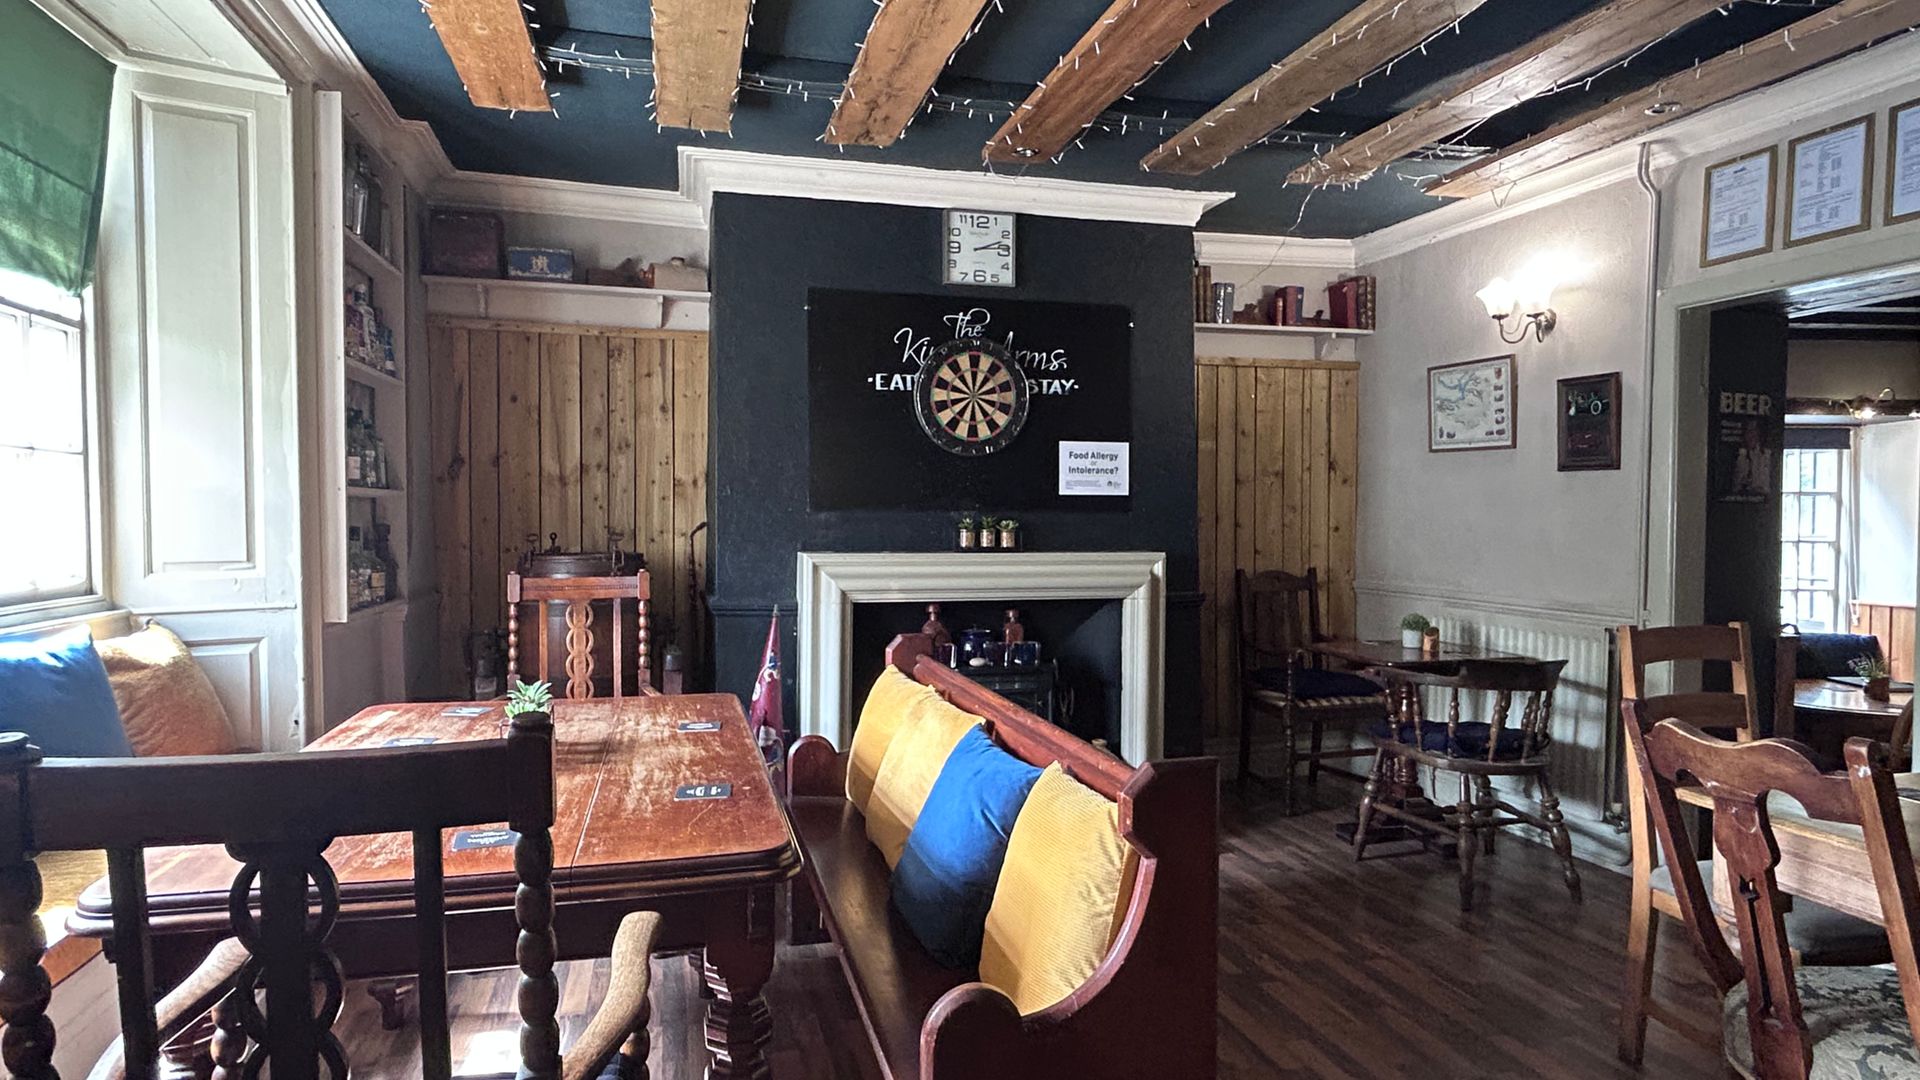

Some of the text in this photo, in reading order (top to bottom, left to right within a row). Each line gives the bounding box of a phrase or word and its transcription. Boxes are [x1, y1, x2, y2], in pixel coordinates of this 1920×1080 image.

[959, 214, 998, 229] 11 12 1
[1001, 230, 1011, 240] 2
[948, 241, 961, 254] 9
[997, 244, 1011, 257] 3
[948, 259, 957, 268] 8
[1001, 262, 1010, 271] 4
[959, 269, 1000, 283] 7 6 5
[943, 308, 991, 339] The
[1720, 391, 1772, 416] BEER
[1068, 451, 1119, 462] Food Allergy
[1068, 466, 1119, 475] Intolerance?
